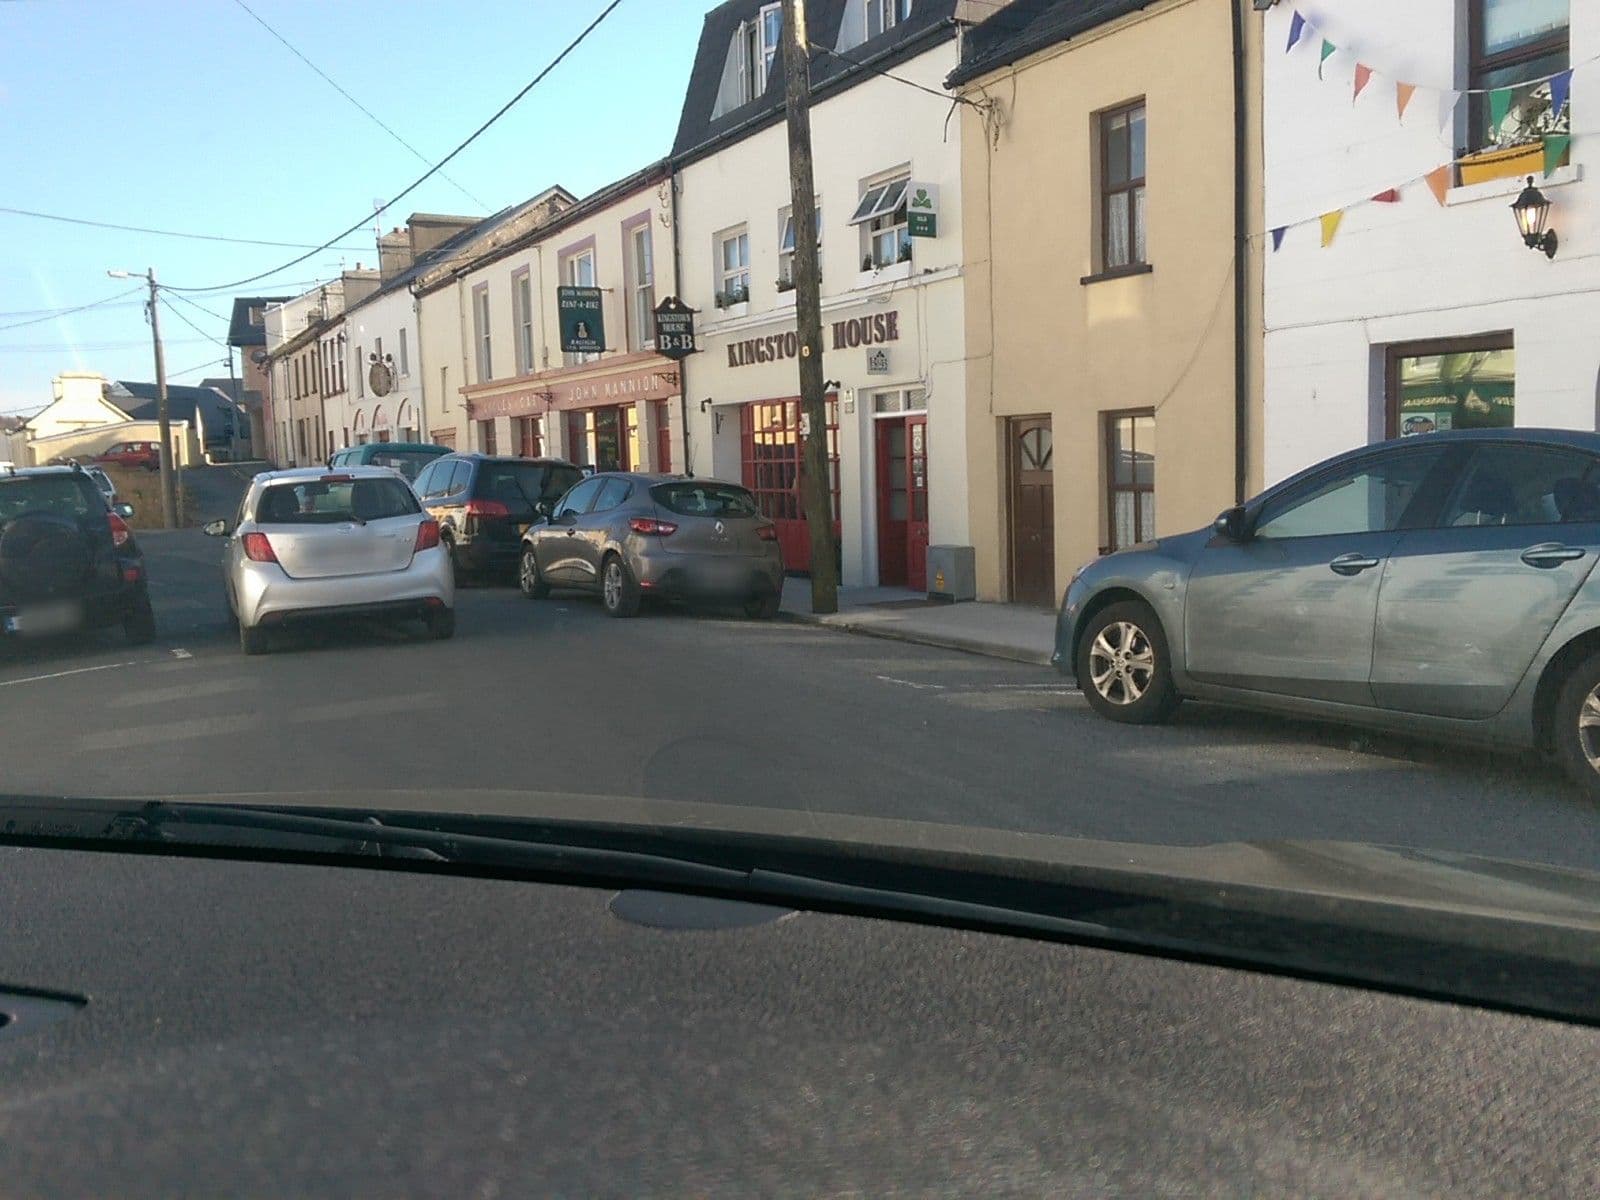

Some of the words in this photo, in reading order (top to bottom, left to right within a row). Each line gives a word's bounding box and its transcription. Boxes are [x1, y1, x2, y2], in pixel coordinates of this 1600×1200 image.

[831, 310, 899, 350] HOUSE
[569, 386, 598, 402] JOHN
[604, 374, 659, 397] MANNION
